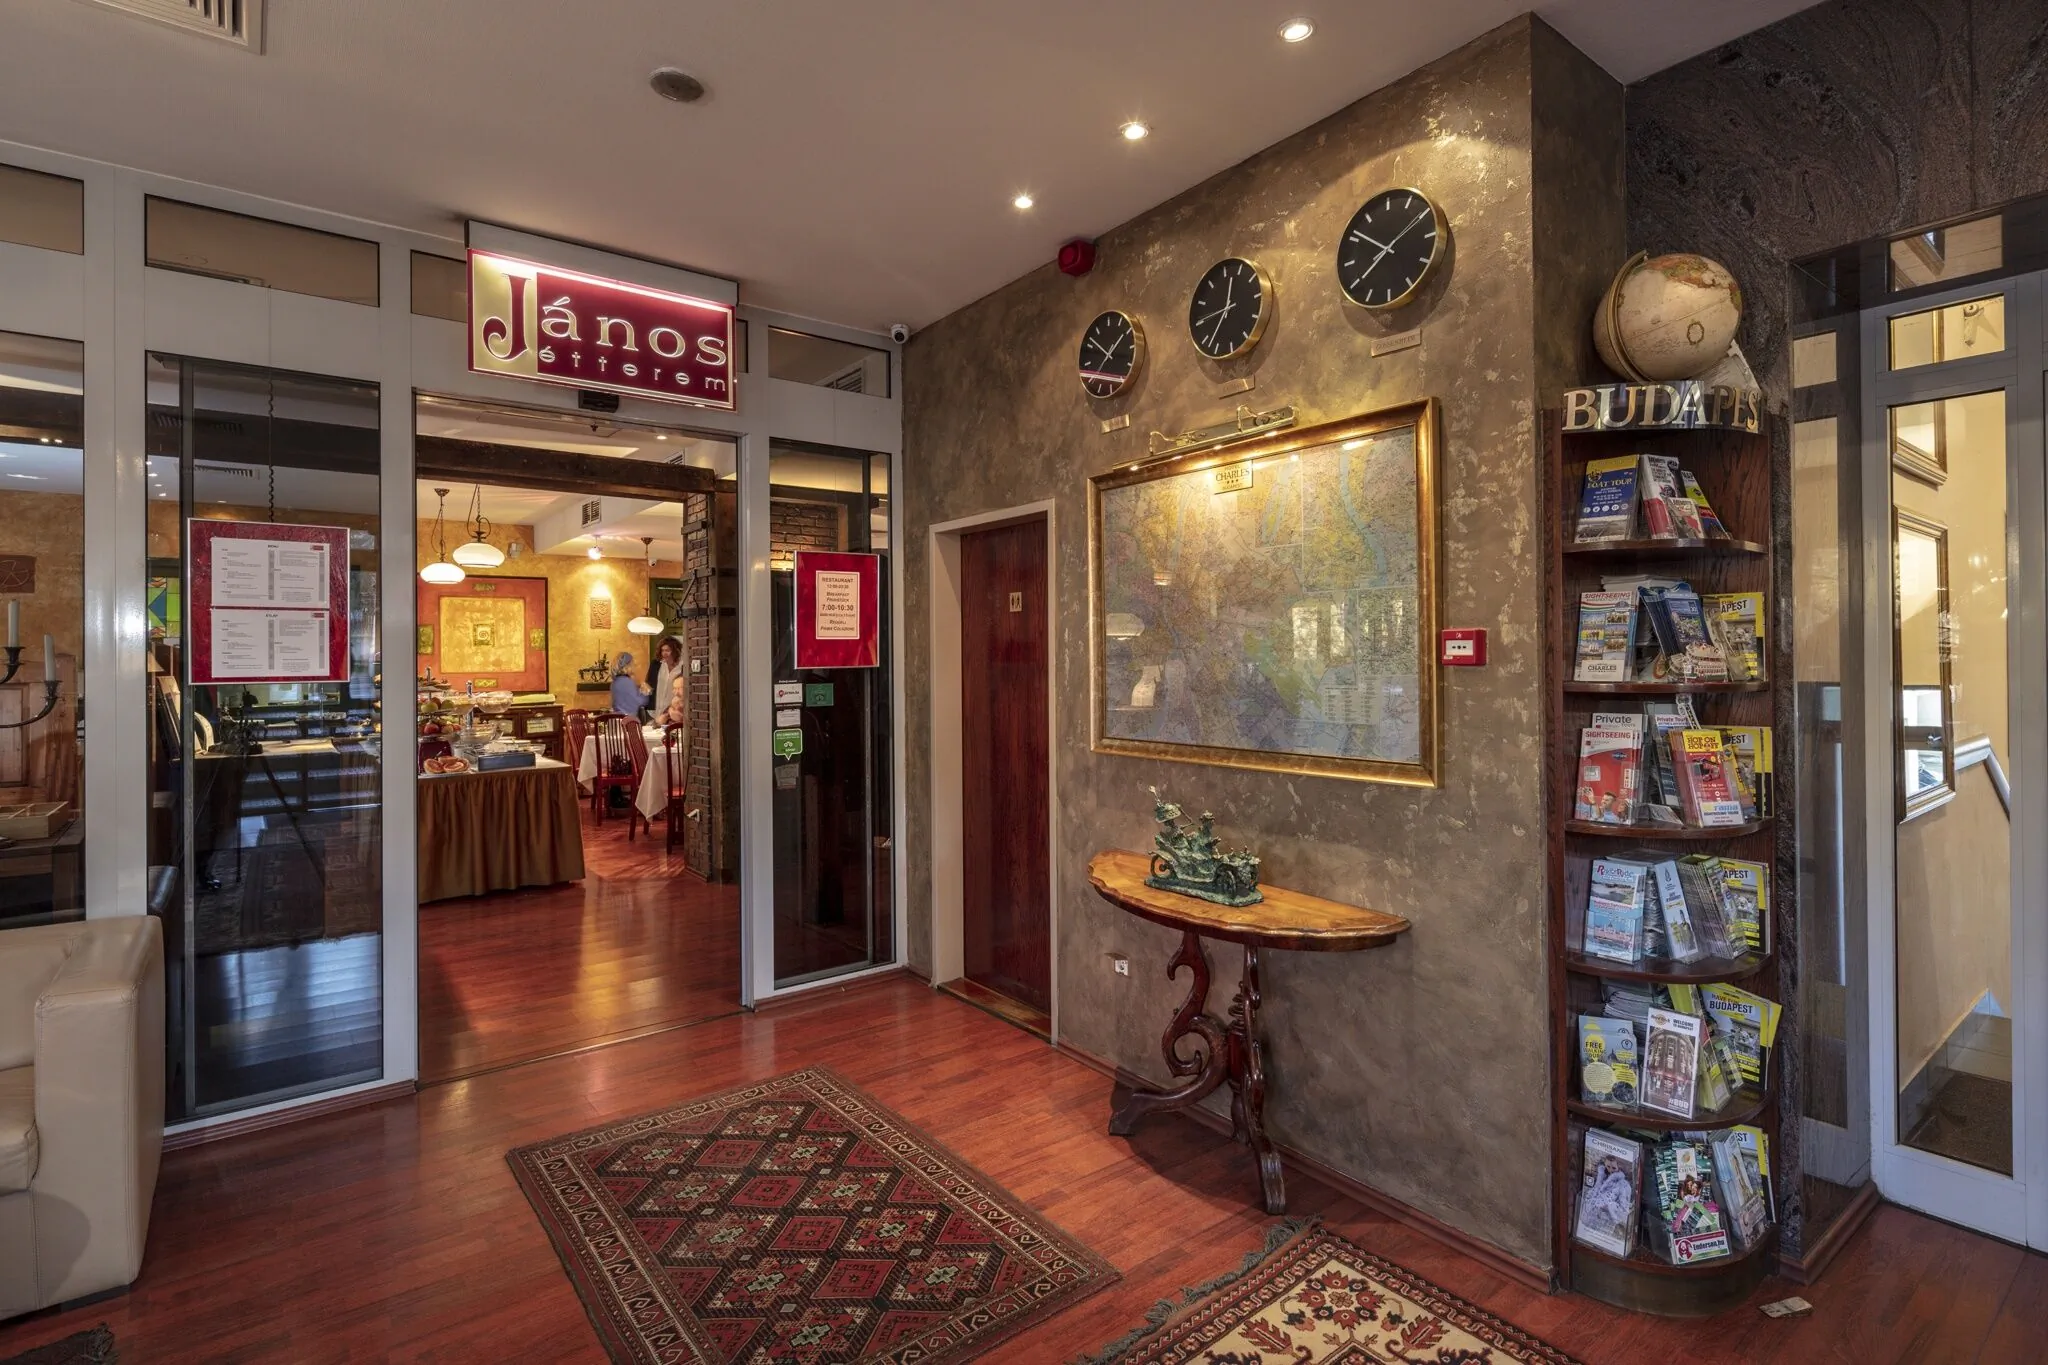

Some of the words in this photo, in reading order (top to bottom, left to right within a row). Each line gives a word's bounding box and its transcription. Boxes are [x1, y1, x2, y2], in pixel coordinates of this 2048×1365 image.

[482, 272, 727, 366] János
[538, 346, 726, 392] étterem
[1561, 381, 1765, 432] BUDAPES
[1216, 469, 1250, 481] CHARLES
[1611, 478, 1633, 487] TOUR
[1584, 591, 1631, 599] SIGHTSEEING
[1721, 600, 1748, 614] APEST
[1595, 715, 1632, 724] Private
[1585, 730, 1631, 739] SIGHTSEEING
[1723, 870, 1749, 879] APEST
[1709, 1000, 1753, 1014] BUDAPEST
[1585, 1041, 1603, 1049] FREE
